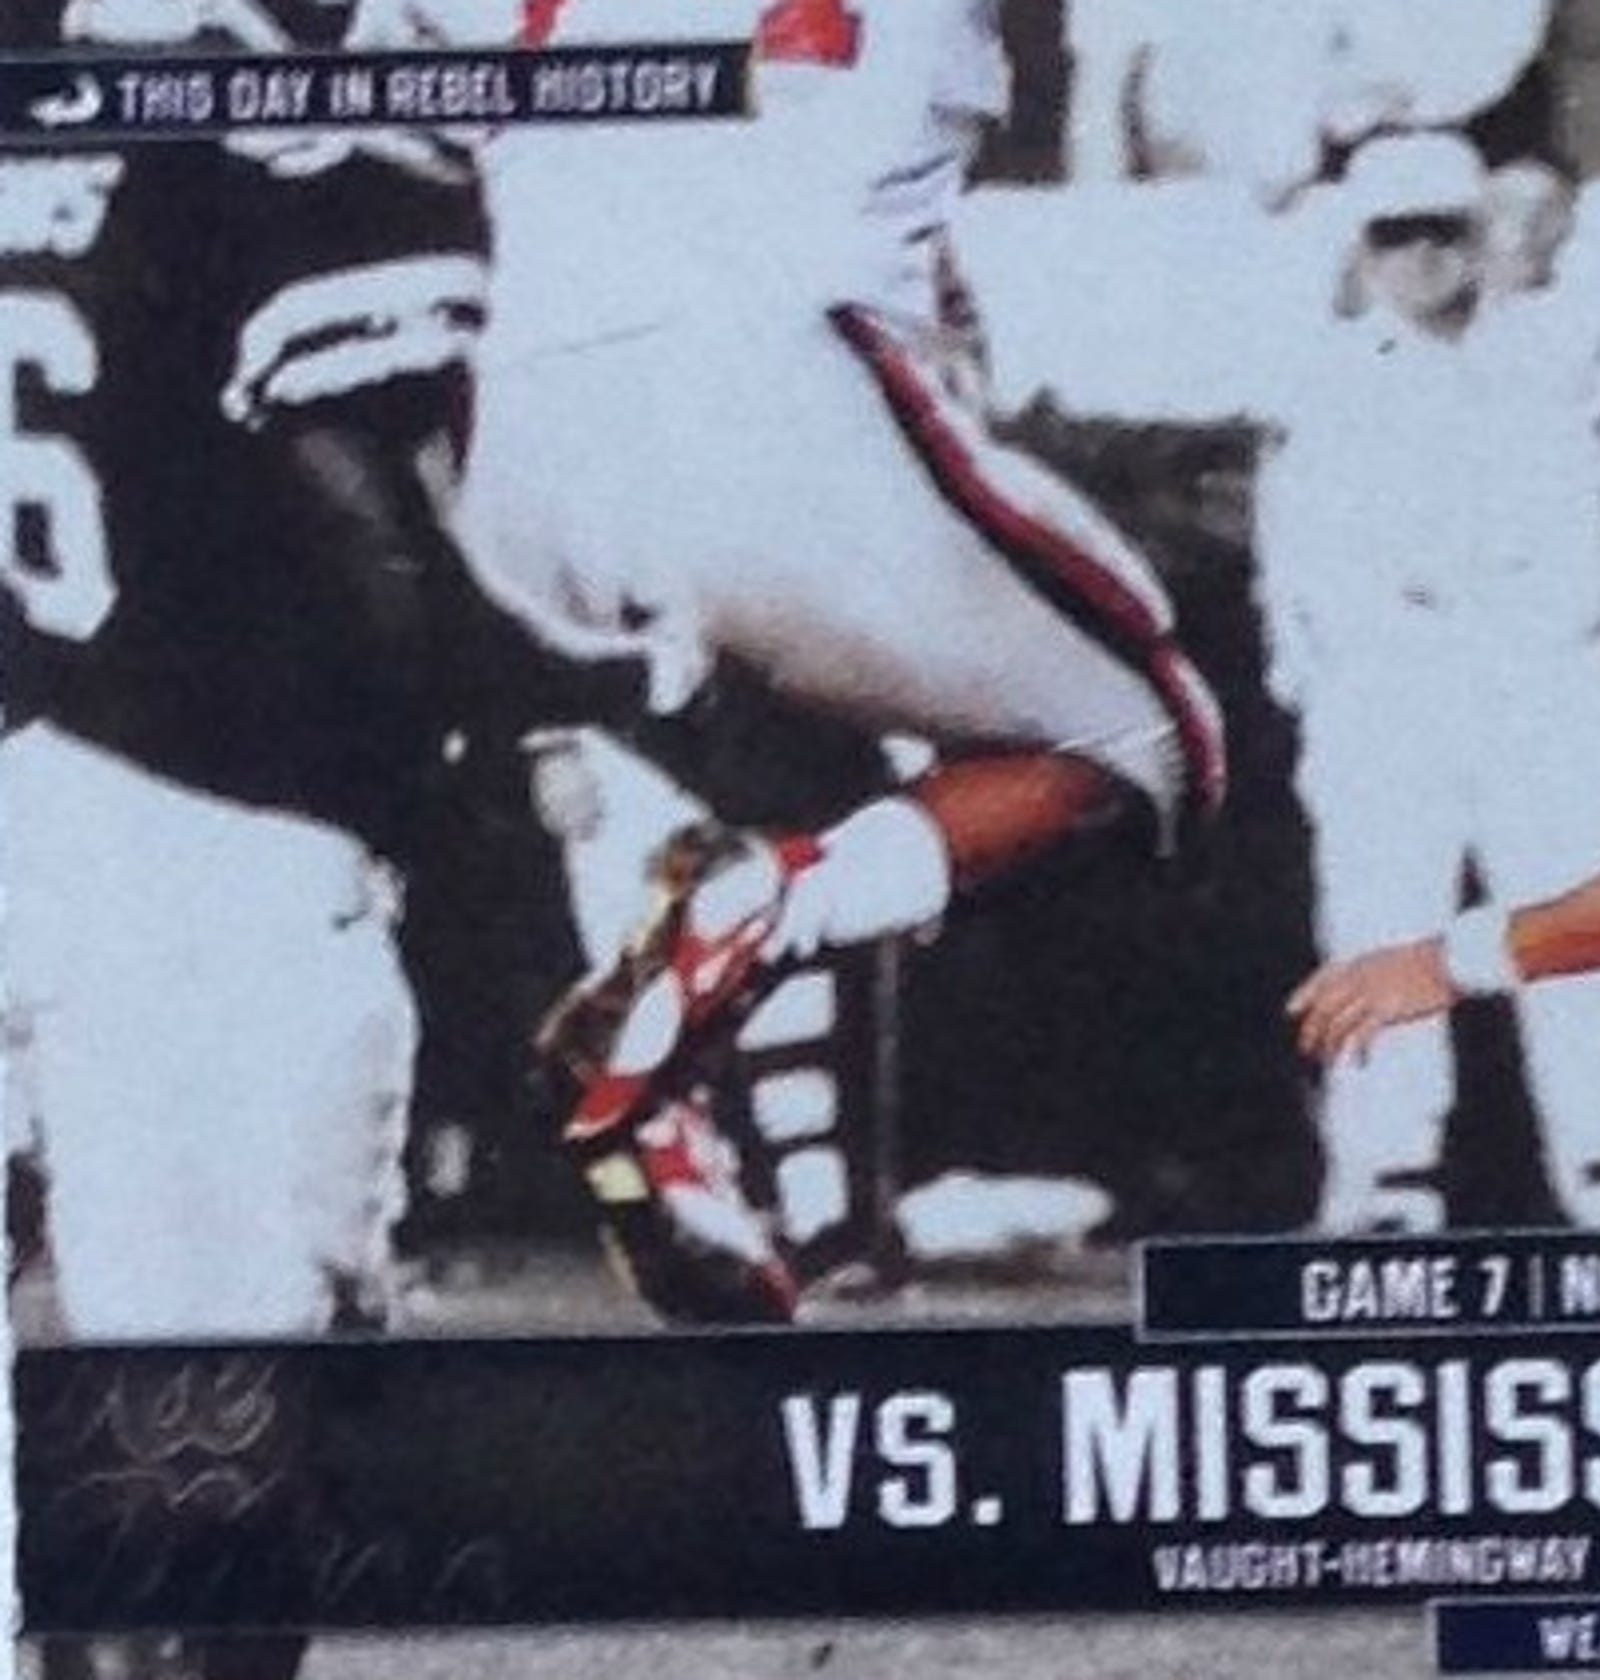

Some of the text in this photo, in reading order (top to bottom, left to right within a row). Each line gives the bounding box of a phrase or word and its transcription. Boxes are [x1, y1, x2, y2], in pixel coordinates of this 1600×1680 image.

[116, 57, 719, 123] THIS DAY IN REBEL HISTORY
[1302, 1257, 1459, 1322] GAME
[1479, 1254, 1511, 1317] 7
[782, 1391, 1002, 1530] VS.
[1152, 1536, 1592, 1591] VAUGHT-HEMINGWAY
